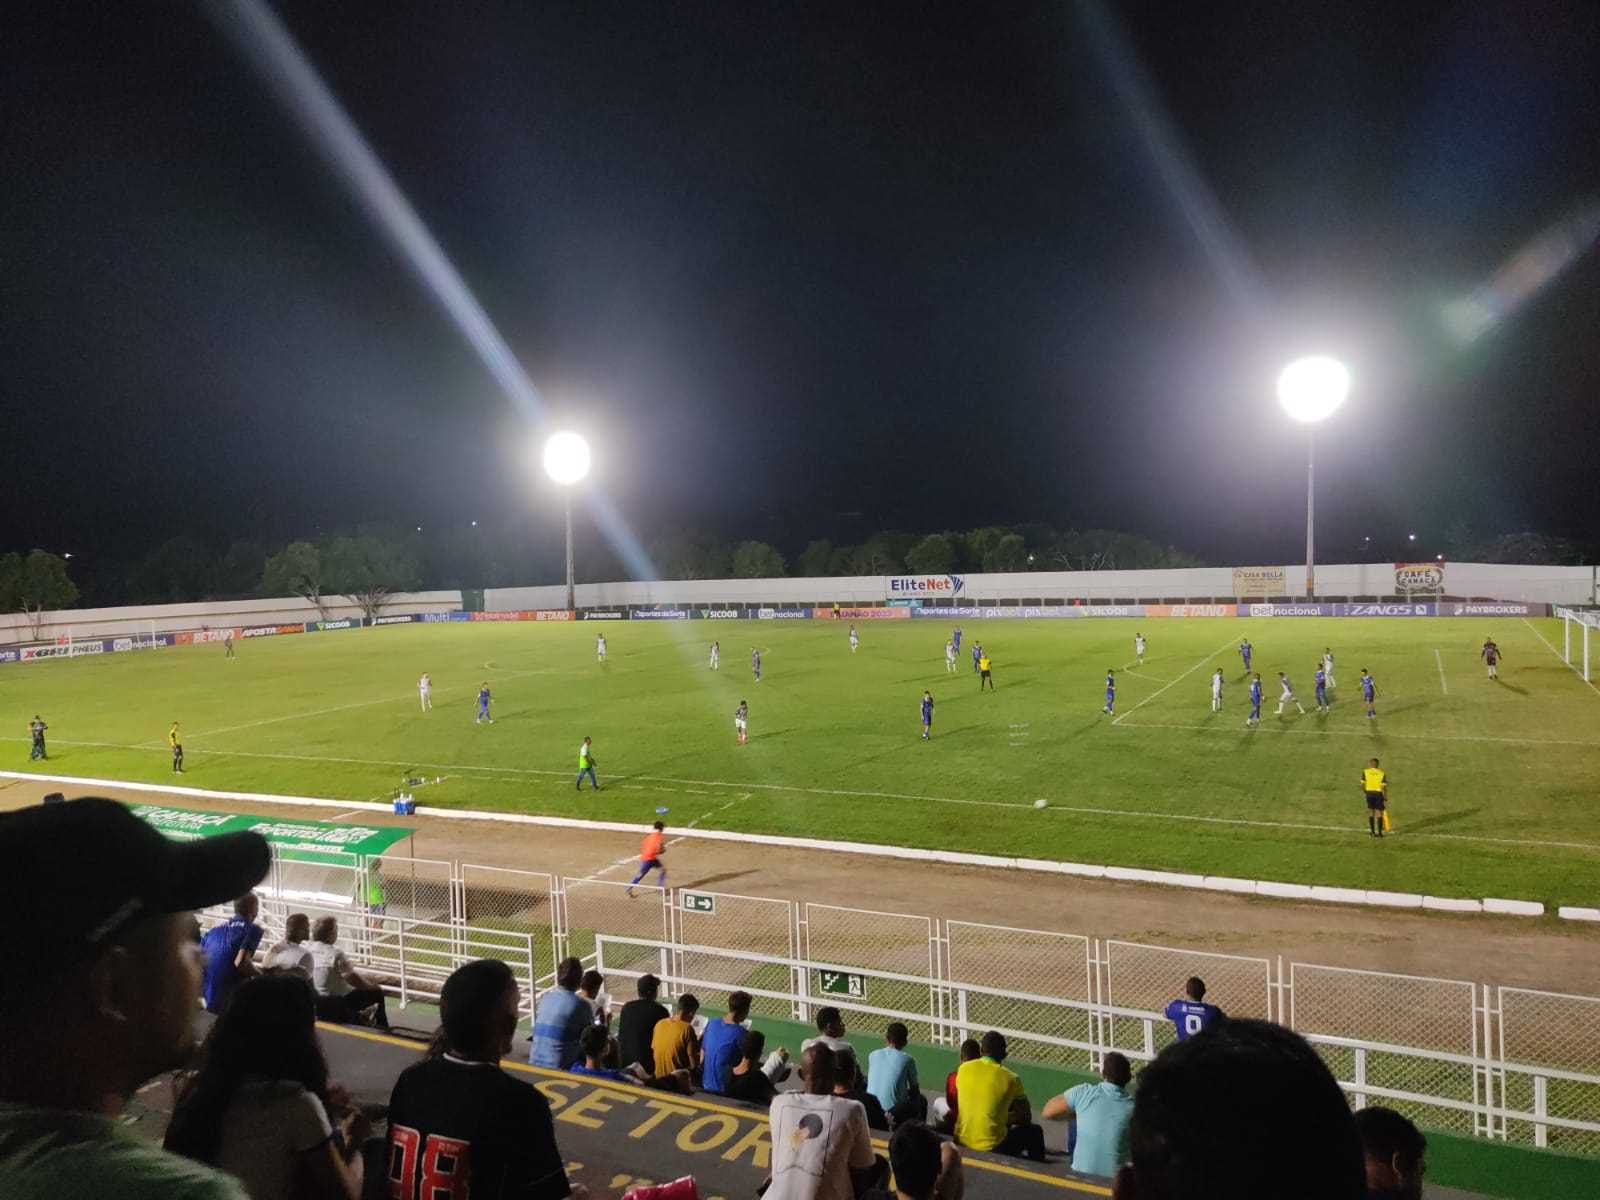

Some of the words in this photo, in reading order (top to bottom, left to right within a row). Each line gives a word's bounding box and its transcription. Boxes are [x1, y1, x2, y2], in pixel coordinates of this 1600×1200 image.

[891, 578, 951, 591] EliteNet
[710, 610, 738, 618] SICOOB
[1171, 605, 1226, 616] BETANO
[1465, 605, 1528, 614] PAYBROKERS
[532, 1078, 772, 1168] SETOR
